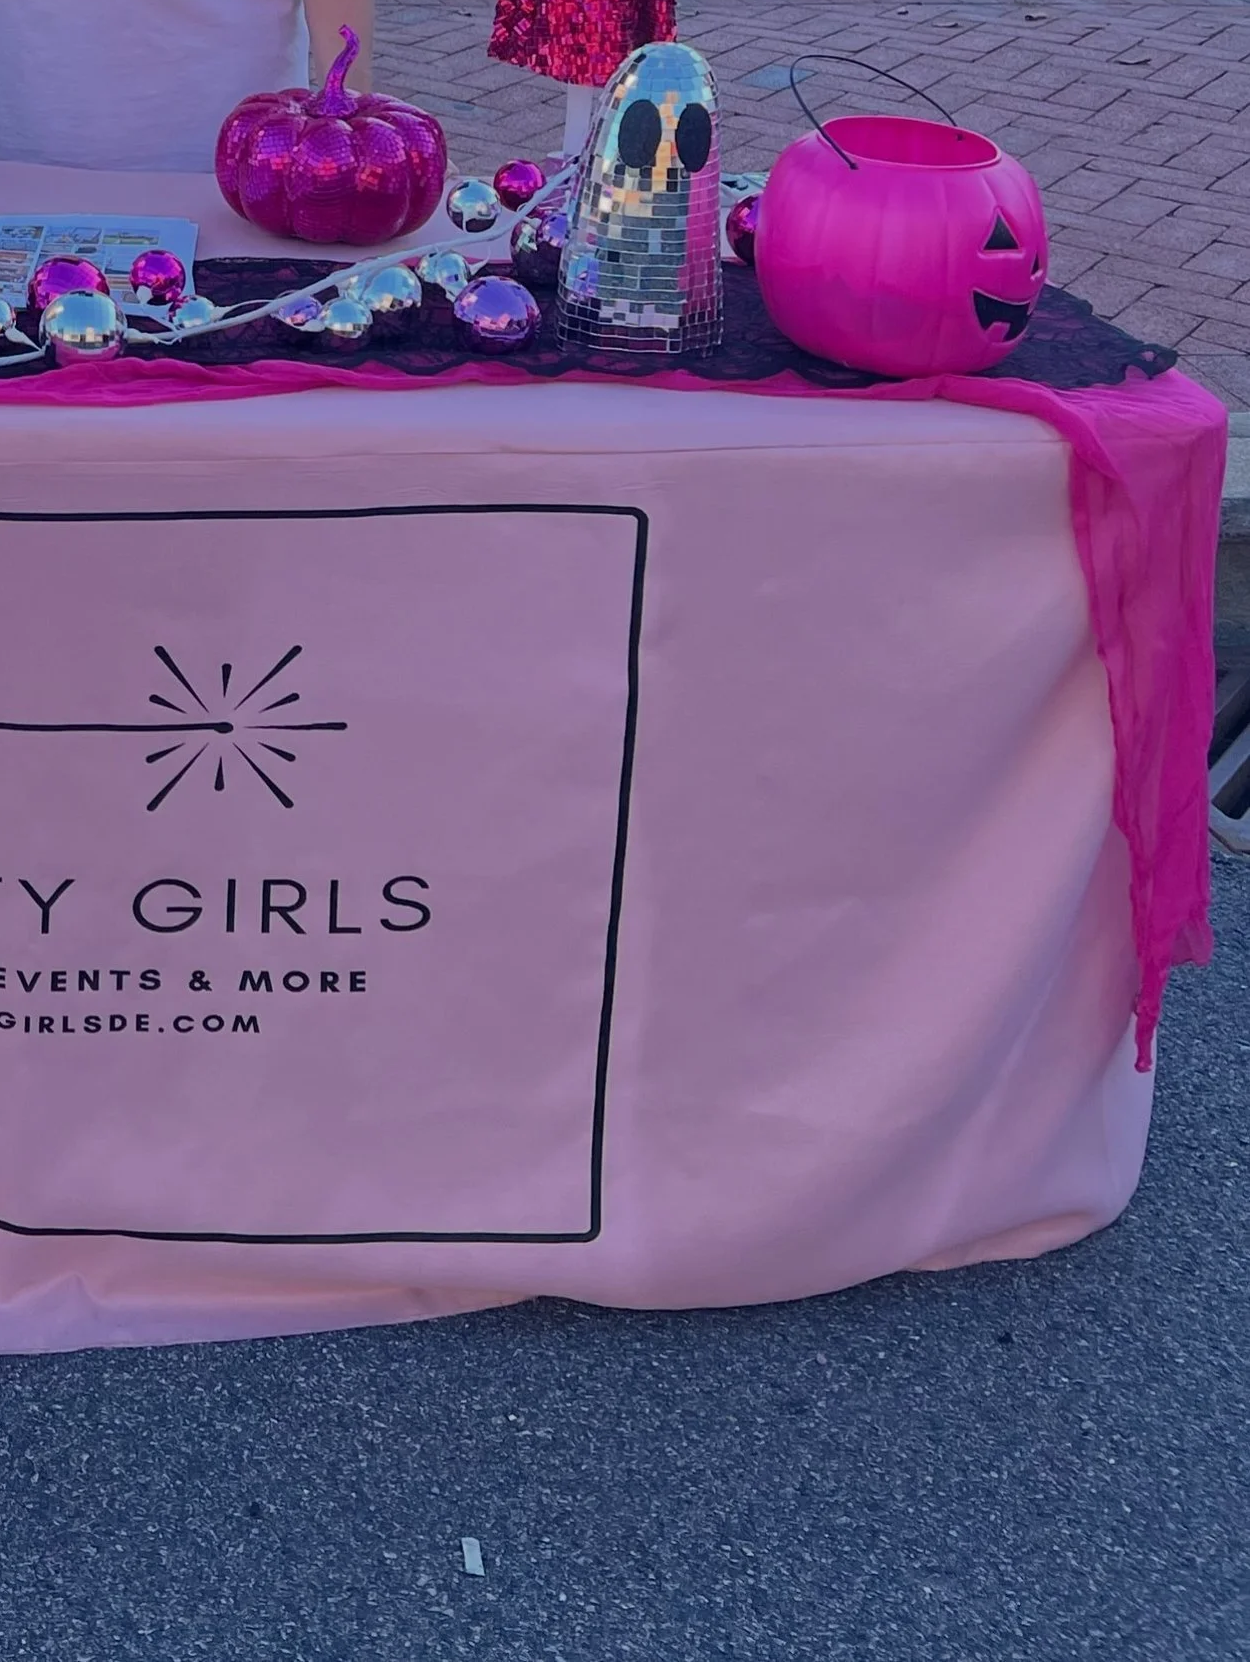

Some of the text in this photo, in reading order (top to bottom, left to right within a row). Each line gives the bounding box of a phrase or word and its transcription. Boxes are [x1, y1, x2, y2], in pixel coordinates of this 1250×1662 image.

[132, 875, 431, 935] GIRLS
[188, 969, 213, 992] &
[238, 969, 367, 993] MORE
